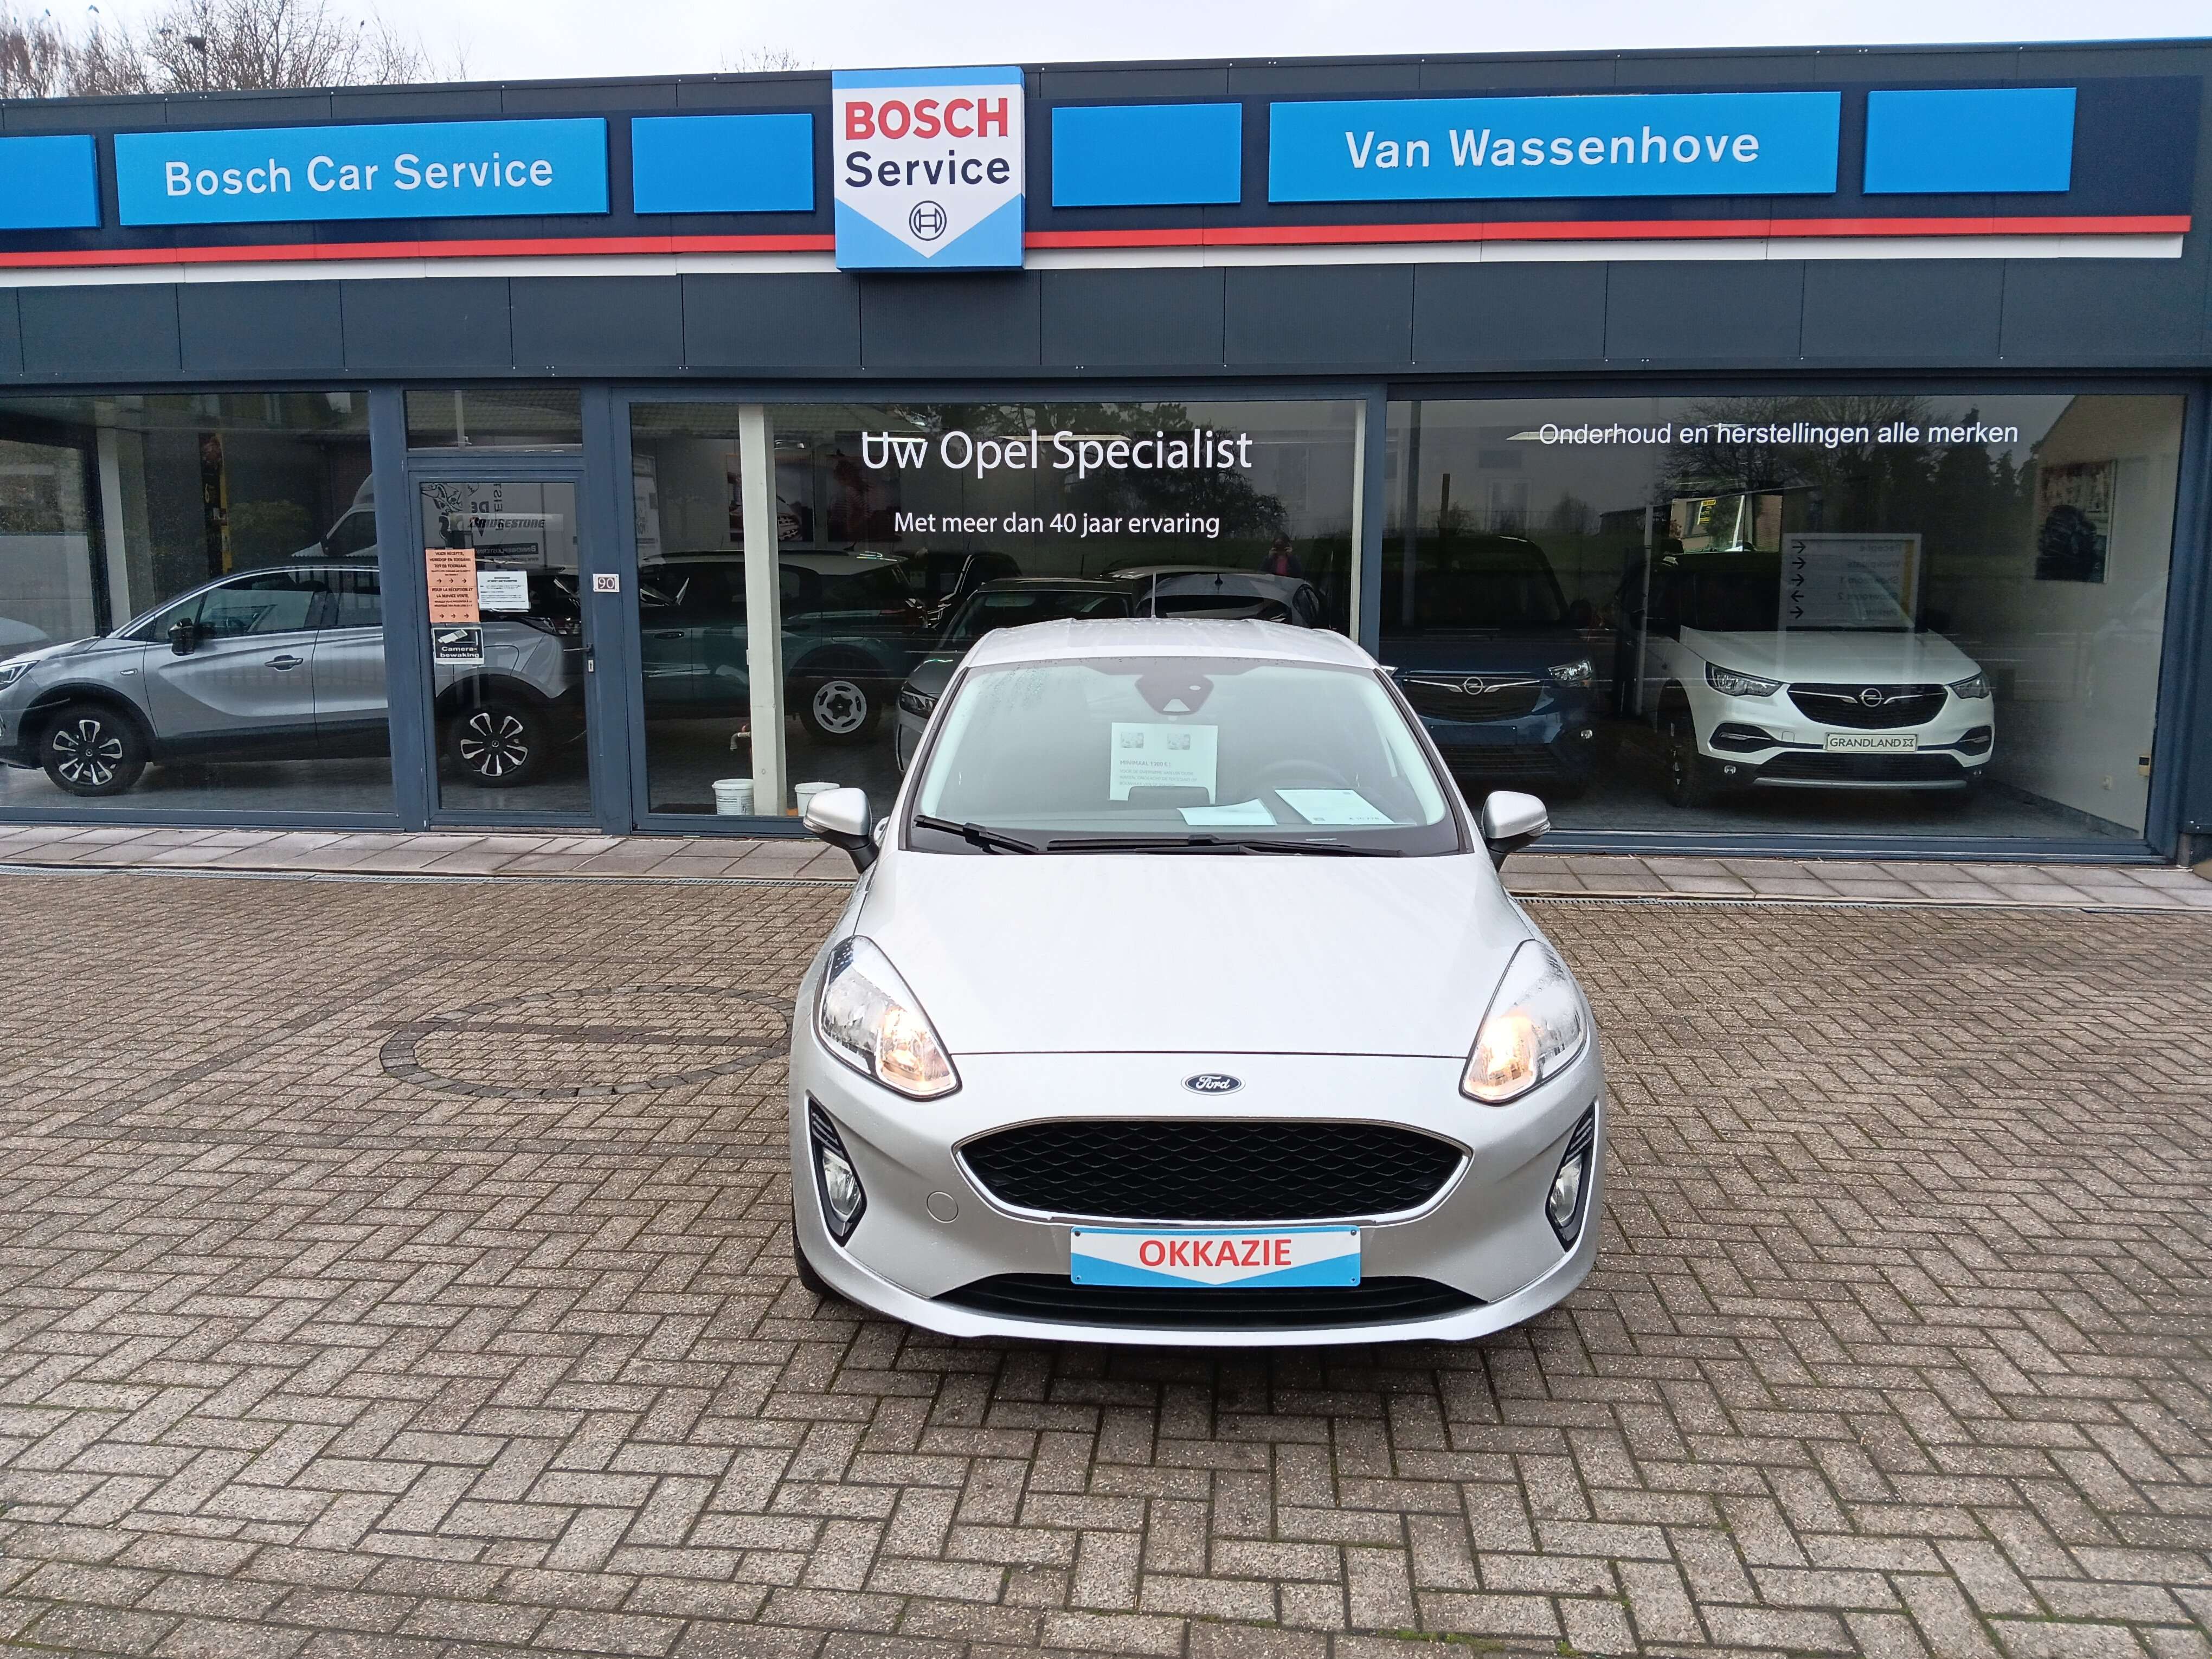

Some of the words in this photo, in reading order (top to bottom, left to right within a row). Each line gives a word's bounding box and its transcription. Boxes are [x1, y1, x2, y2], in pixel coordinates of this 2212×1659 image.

[845, 98, 1008, 140] BOSCH
[1346, 131, 1430, 169] Van
[1449, 126, 1759, 166] Wassenhove
[165, 158, 291, 196] Bosch
[307, 155, 378, 192] Car
[394, 152, 554, 190] Service
[845, 150, 1010, 188] Service
[1539, 422, 1671, 445] Onderhoud
[1680, 427, 1708, 443] en
[1716, 422, 1869, 448] herstellingen
[1877, 422, 1920, 443] alle
[1928, 422, 2018, 443] merken
[862, 431, 928, 469] Uw
[940, 429, 1038, 479] Opel
[1052, 428, 1253, 479] Specialist
[895, 512, 936, 532] Met
[942, 517, 998, 532] meer
[1003, 511, 1043, 532] dan
[1050, 513, 1076, 533] 40
[1080, 513, 1123, 538] jaar
[1128, 513, 1220, 538] ervaring
[598, 578, 614, 589] 90
[1830, 738, 1901, 747] GRANDLAND
[1902, 738, 1915, 747] X
[1195, 1075, 1231, 1089] Ford
[1139, 1239, 1291, 1266] OKKAZIE
